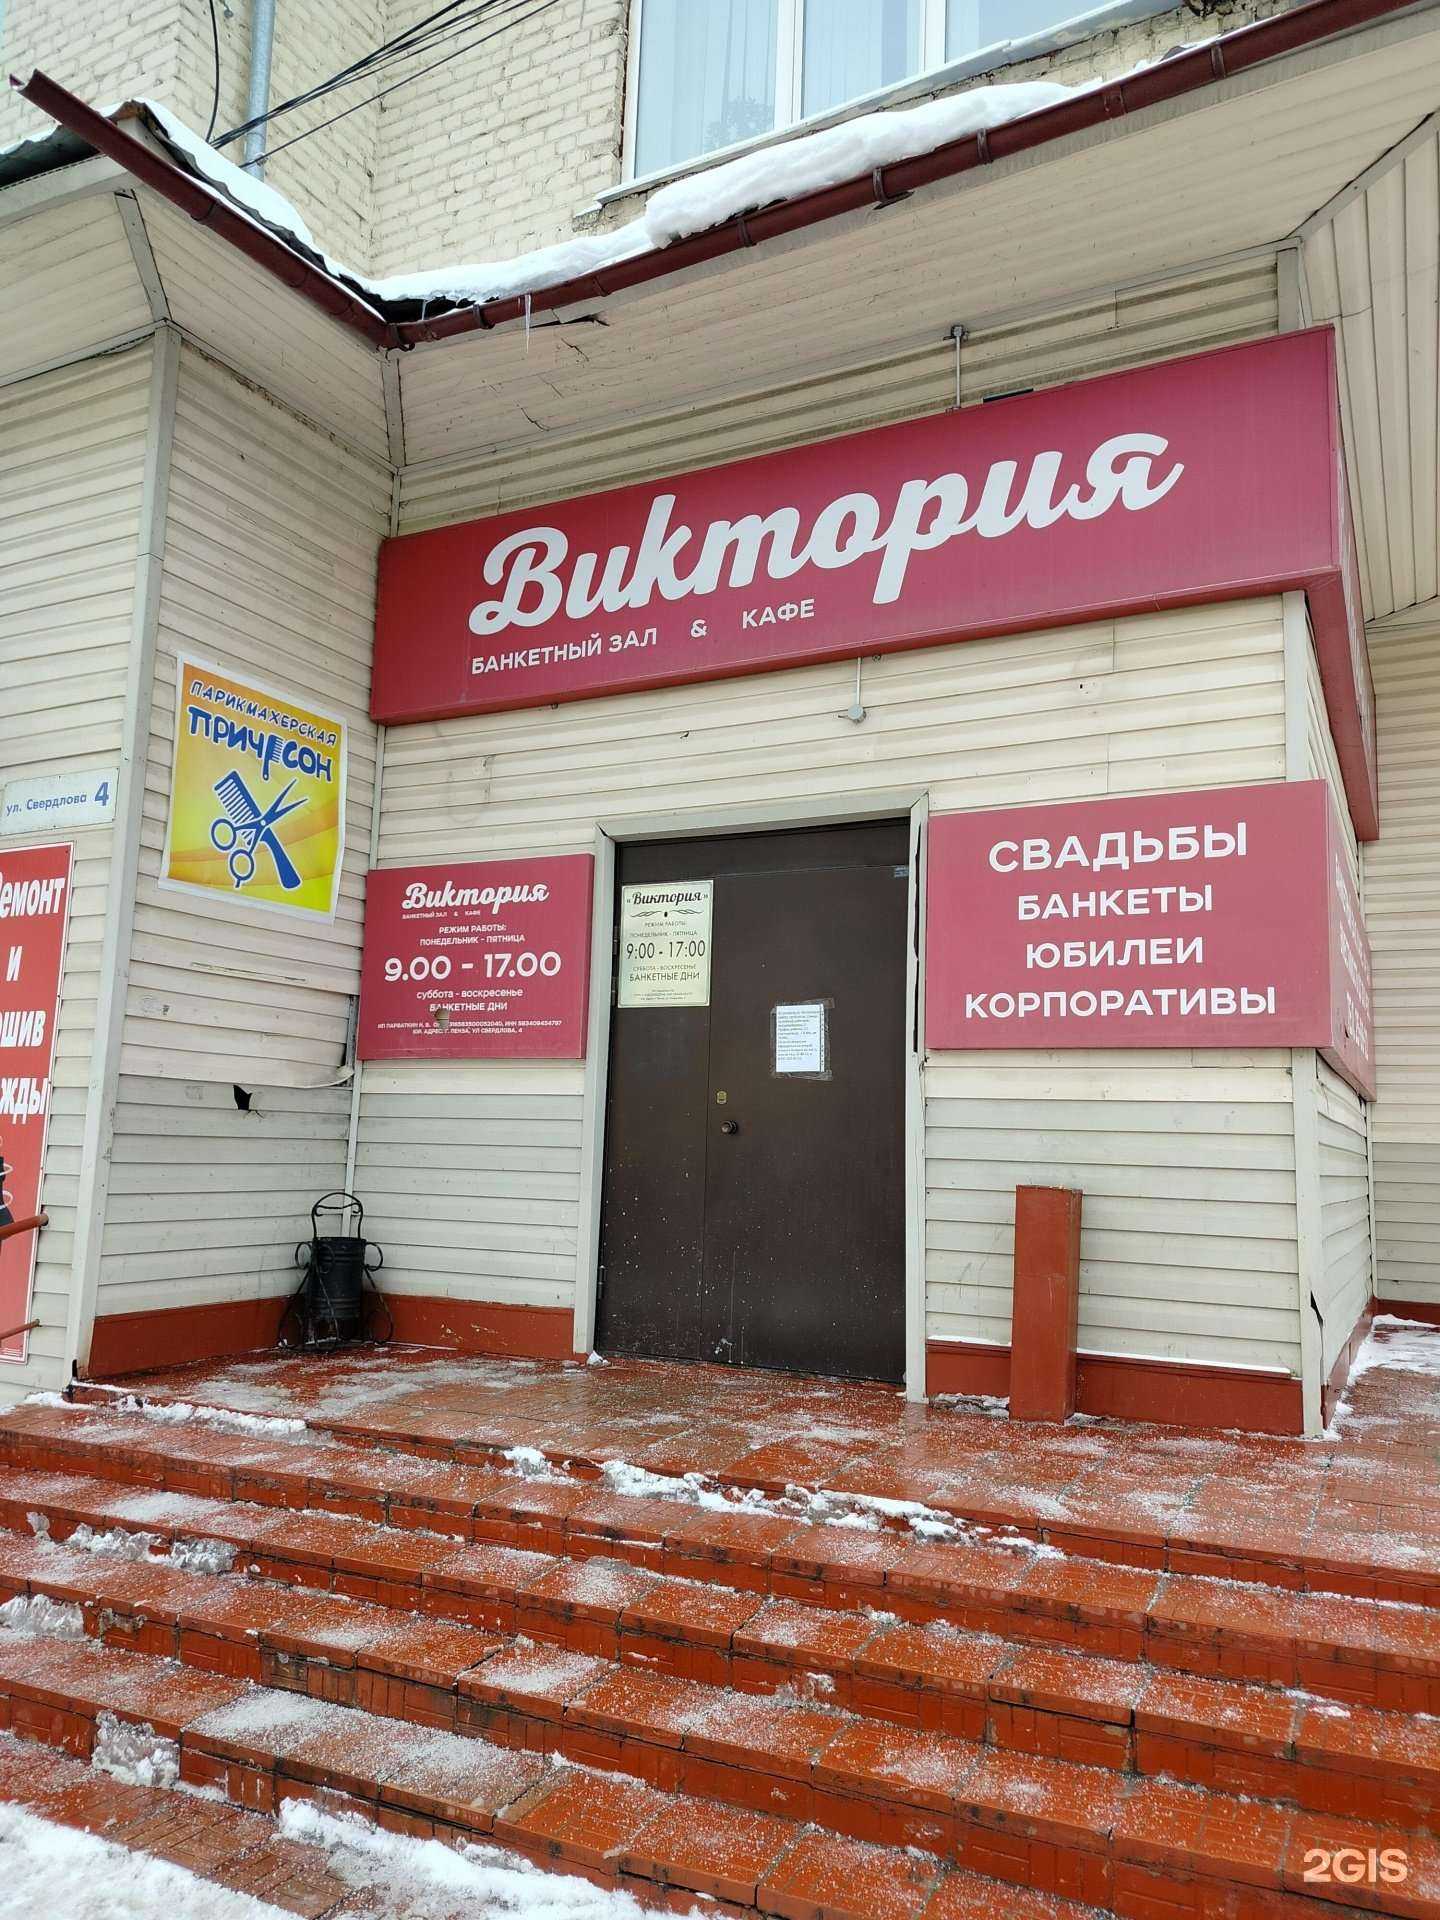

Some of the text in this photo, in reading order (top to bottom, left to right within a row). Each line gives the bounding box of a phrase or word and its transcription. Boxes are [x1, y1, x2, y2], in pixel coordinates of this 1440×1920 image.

[468, 432, 1184, 636] Виктория
[472, 598, 815, 675] БАНКЕТНЫЙ ЗАЛ & КАФЕ
[190, 681, 337, 746] ПАРИКМАХЕРСКАЯ
[6, 782, 109, 816] ул. Свердлова 4
[988, 822, 1247, 873] СВАДЬБЫ
[0, 872, 65, 918] емонт
[402, 881, 550, 914] Виктория
[1018, 885, 1213, 921] БАНКЕТЫ
[420, 936, 479, 947] ПОНЕДЕЛЬНИК
[486, 934, 525, 944] ПЯТНИЦА
[439, 925, 469, 934] РЕЖИМ
[626, 942, 655, 959] 9:00
[669, 940, 706, 958] 17:00
[1026, 937, 1204, 969] ЮБИЛЕИ
[384, 956, 452, 982] 9.00
[484, 951, 562, 978] 17.00
[630, 972, 699, 982] БАНКЕТНЫЕ ДНИ
[416, 989, 453, 1000] суббота
[461, 988, 523, 999] воскресенье
[487, 1002, 508, 1012] ДНИ
[965, 986, 1275, 1019] КОРПОРАТИВЫ
[0, 1011, 46, 1047] шив
